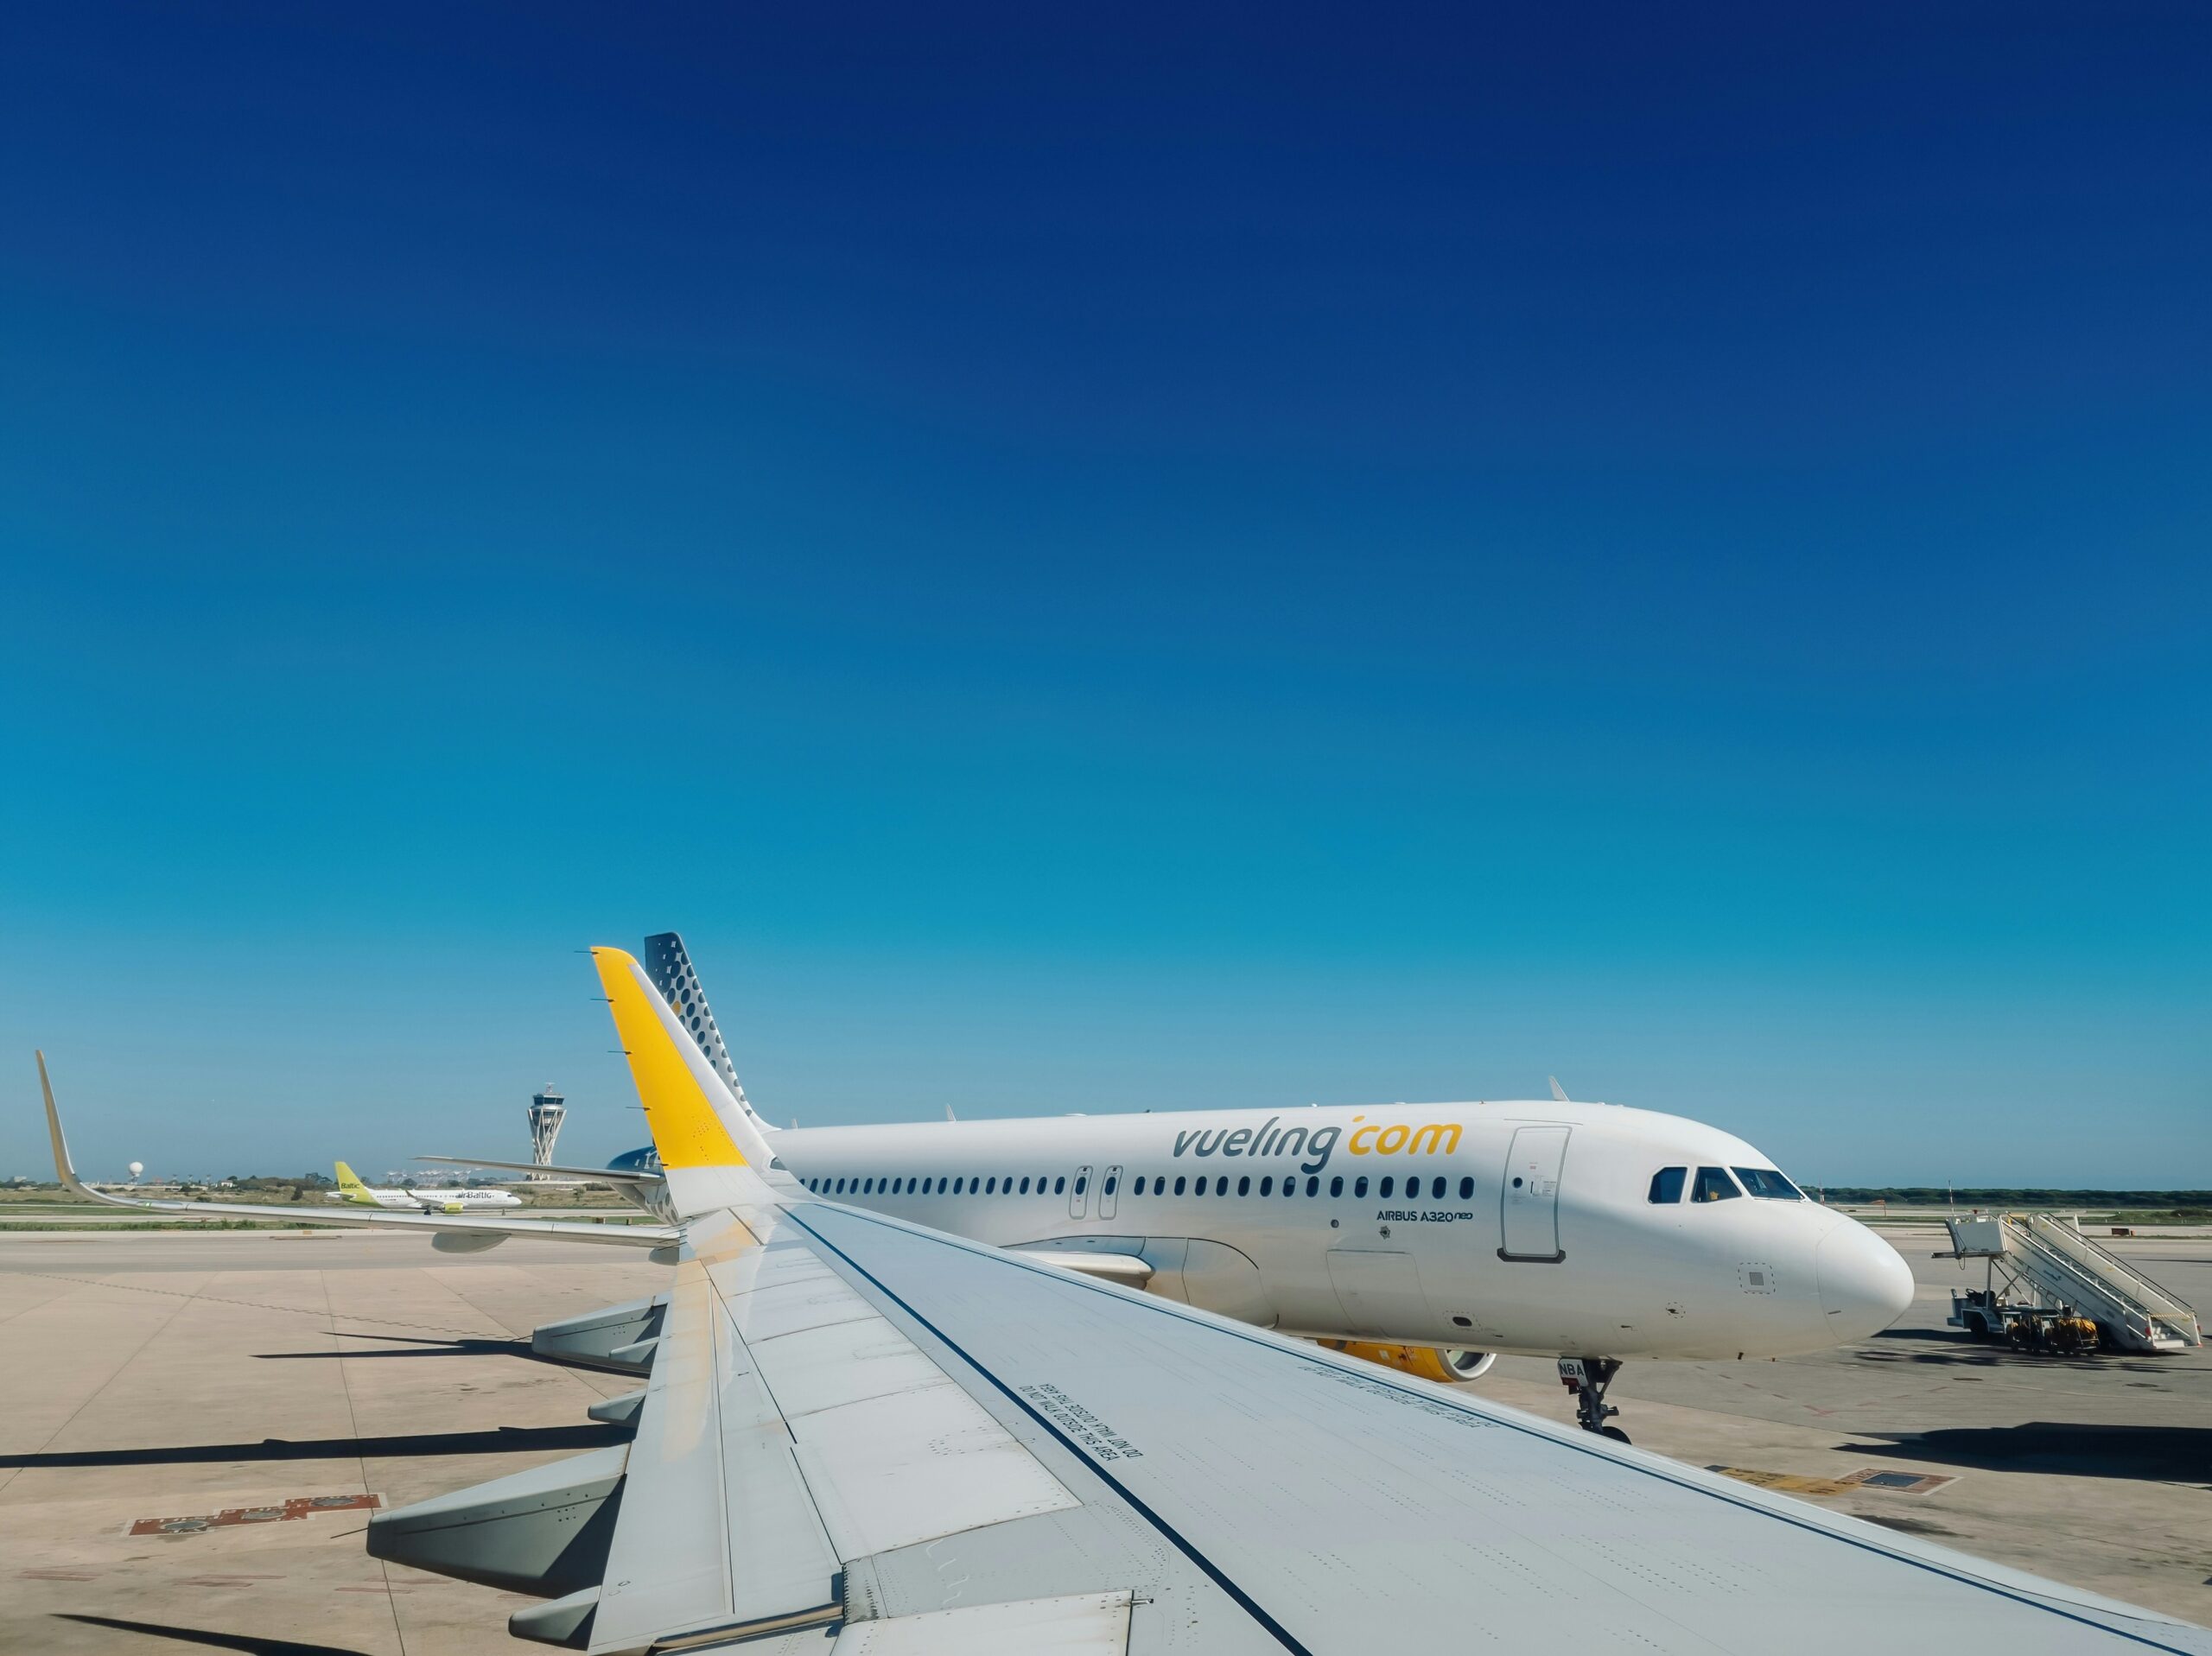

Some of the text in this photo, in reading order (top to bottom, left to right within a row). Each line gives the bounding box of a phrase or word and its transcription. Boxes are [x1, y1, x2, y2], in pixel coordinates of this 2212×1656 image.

[1376, 1210, 1418, 1221] AIRBUS
[1560, 1364, 1584, 1376] NBA
[1026, 1392, 1048, 1400] NOT
[1038, 1400, 1065, 1414] WALK
[1053, 1412, 1088, 1433] OUTSIDE
[1077, 1432, 1103, 1444] THIS
[1091, 1446, 1121, 1461] AREA
[1039, 1384, 1144, 1458] DO NOT WALK OUTSIDE THIS AREA
